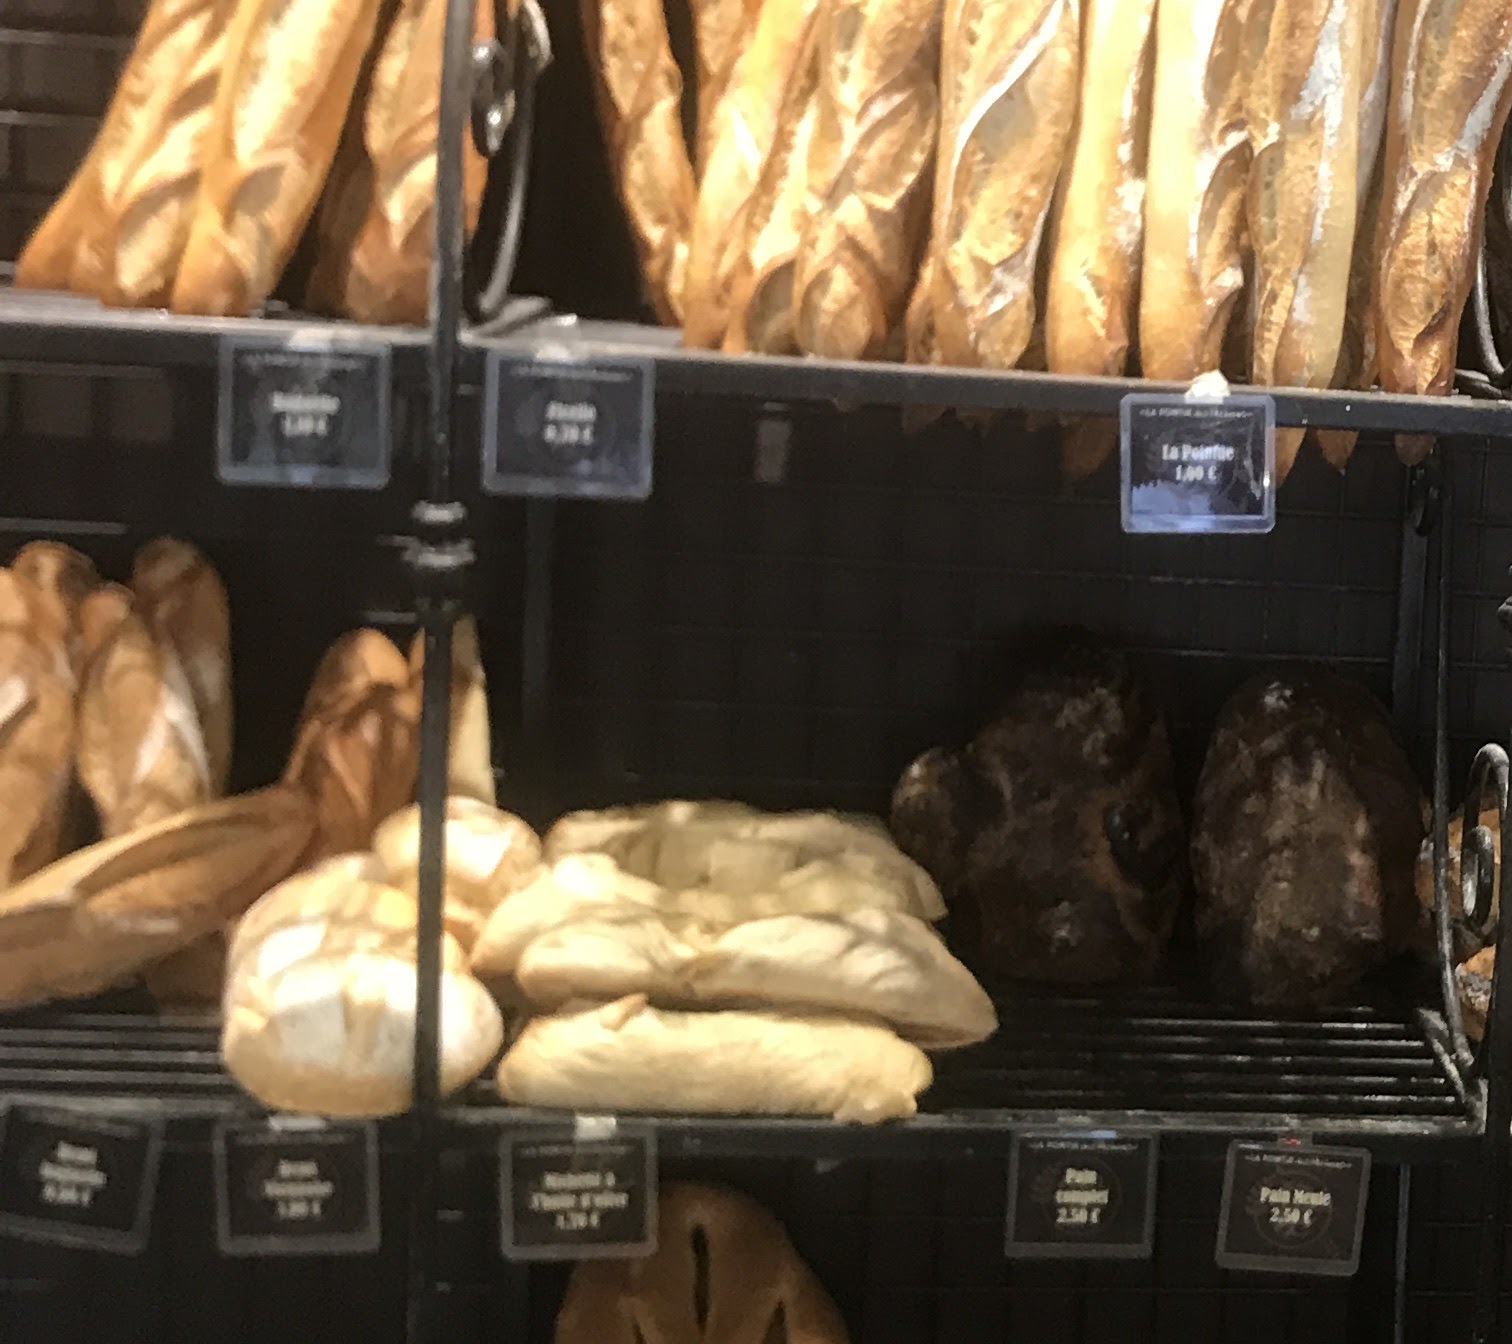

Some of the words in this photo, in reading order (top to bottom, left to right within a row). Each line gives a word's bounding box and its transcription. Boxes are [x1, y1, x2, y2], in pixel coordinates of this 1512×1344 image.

[1162, 444, 1178, 461] La
[1260, 1186, 1290, 1204] Pain
[1269, 1206, 1300, 1225] 2,50
[1303, 1208, 1313, 1228] €
